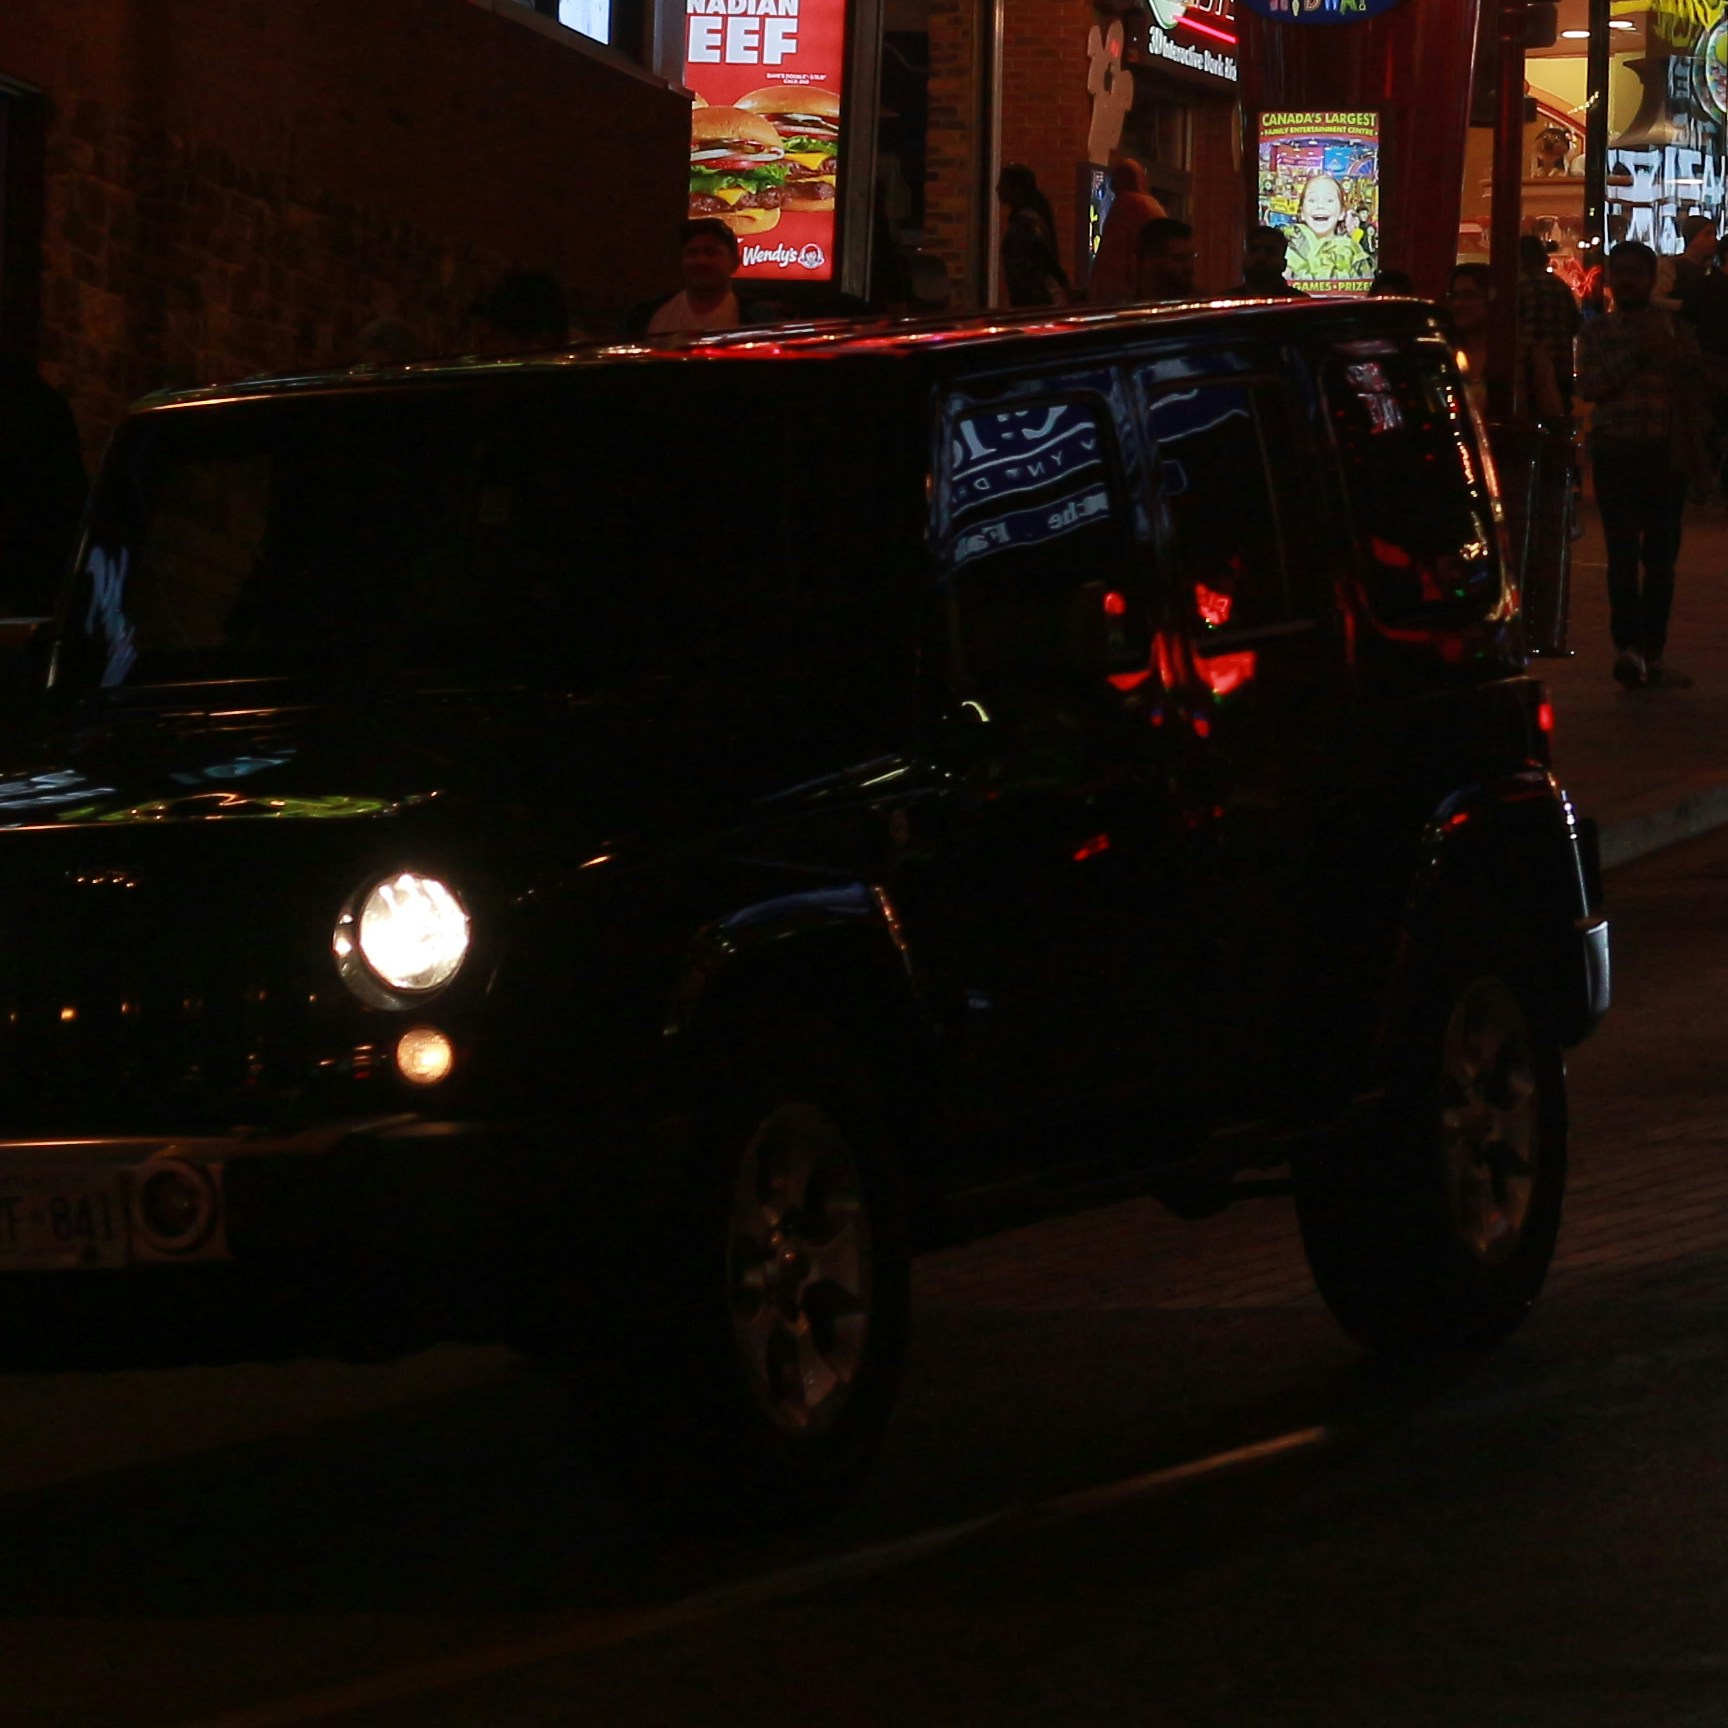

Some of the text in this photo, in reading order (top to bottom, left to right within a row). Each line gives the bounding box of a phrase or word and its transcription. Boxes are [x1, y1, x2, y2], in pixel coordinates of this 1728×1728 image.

[687, 16, 800, 65] EEF
[1262, 112, 1377, 127] CANADA'S LARGEST
[742, 241, 799, 268] Wendy's
[1292, 280, 1374, 292] GAMES PRIZE
